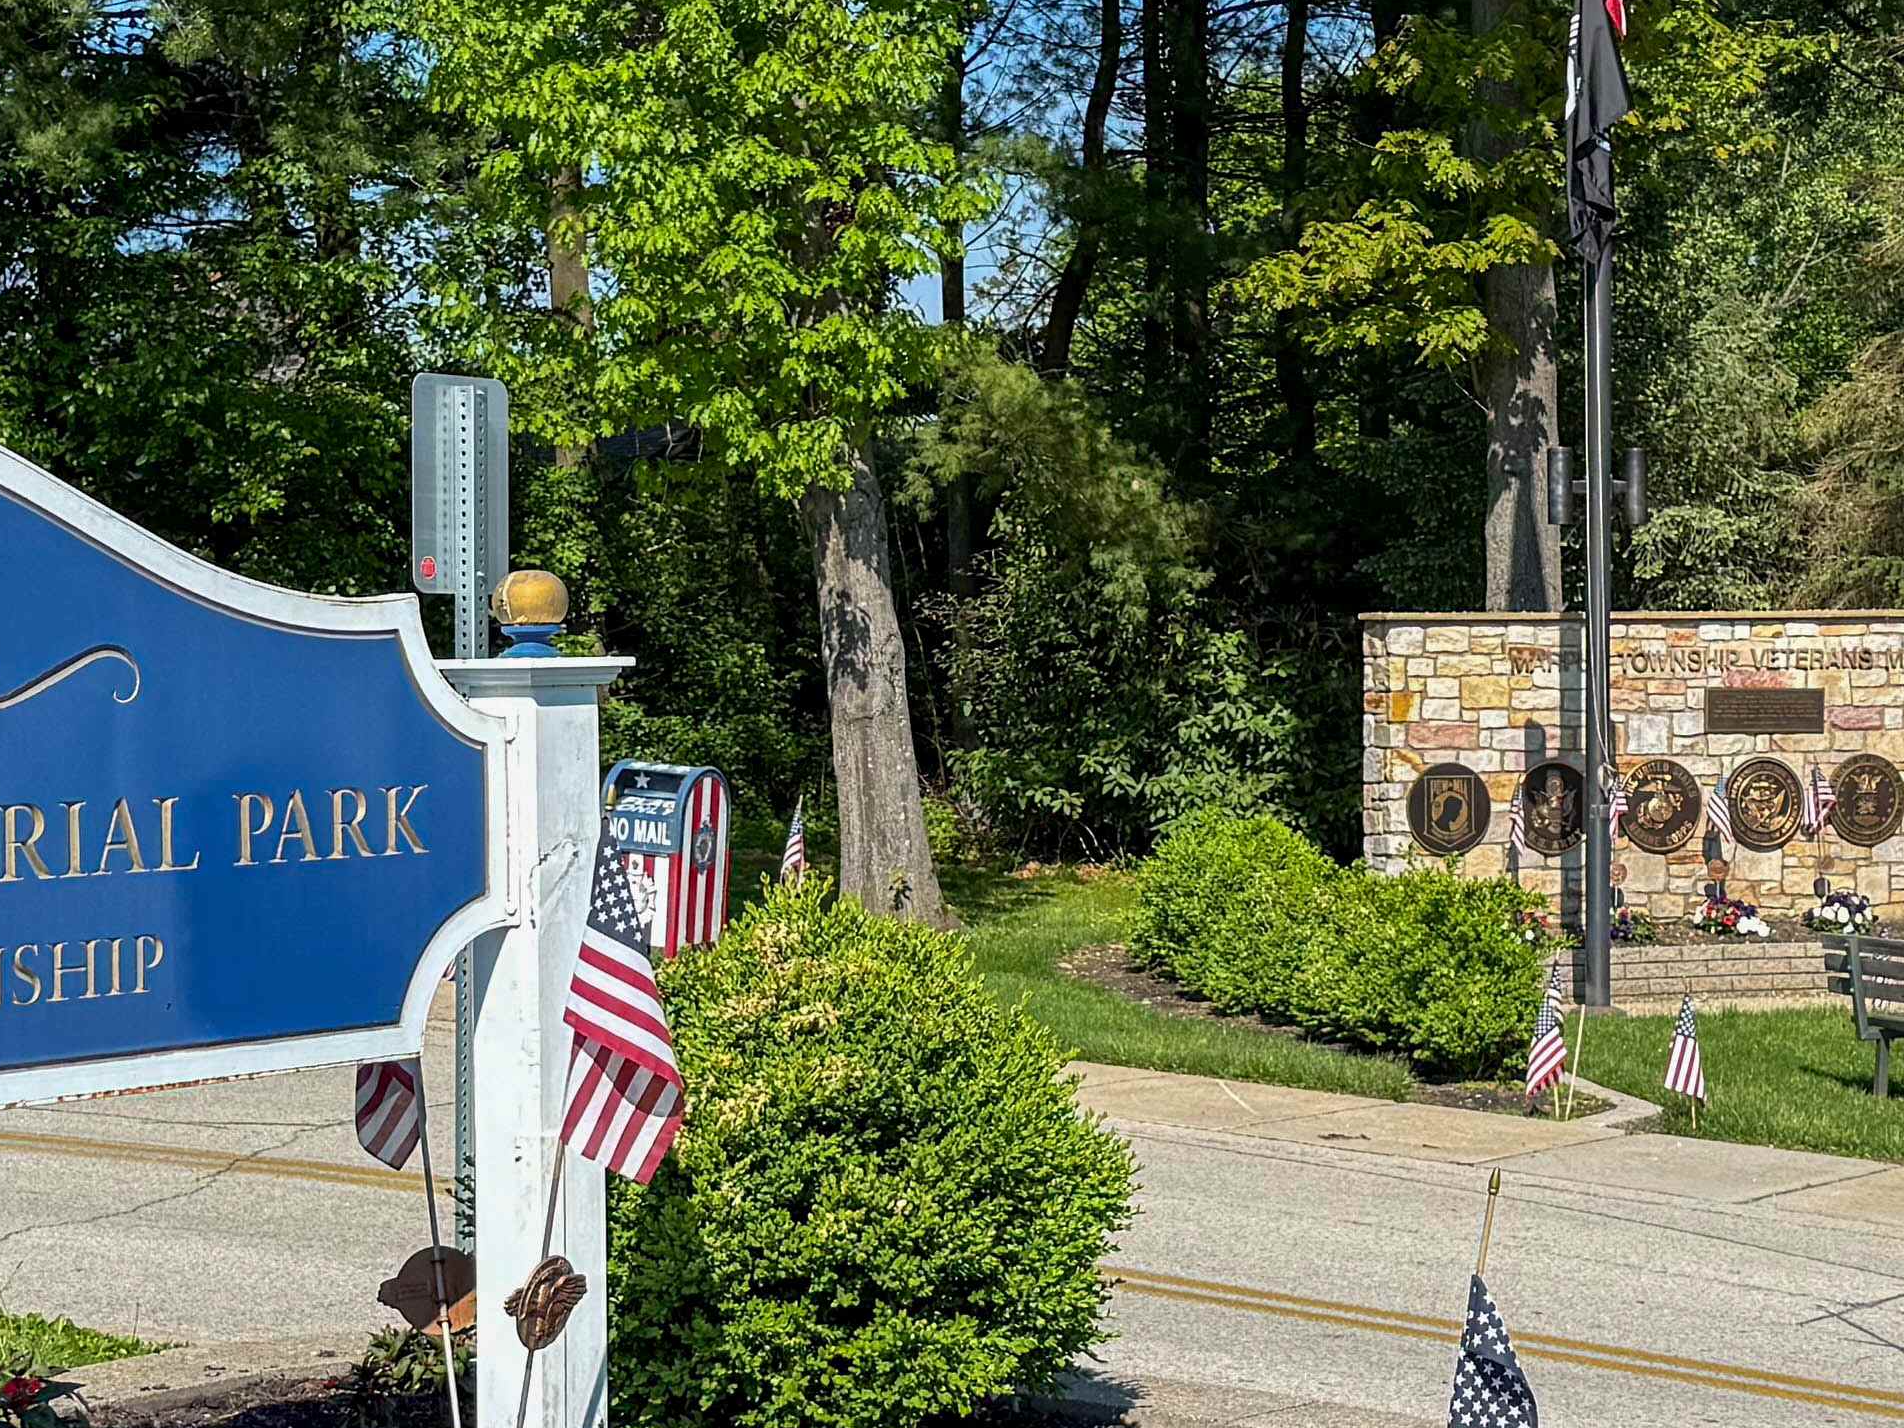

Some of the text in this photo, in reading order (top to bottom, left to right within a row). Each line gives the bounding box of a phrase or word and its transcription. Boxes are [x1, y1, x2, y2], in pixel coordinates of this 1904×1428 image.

[1621, 650, 1740, 674] TOWNSHIP
[1750, 647, 1873, 670] VETERANS
[232, 783, 430, 869] PARK
[609, 817, 671, 846] NO MAIL
